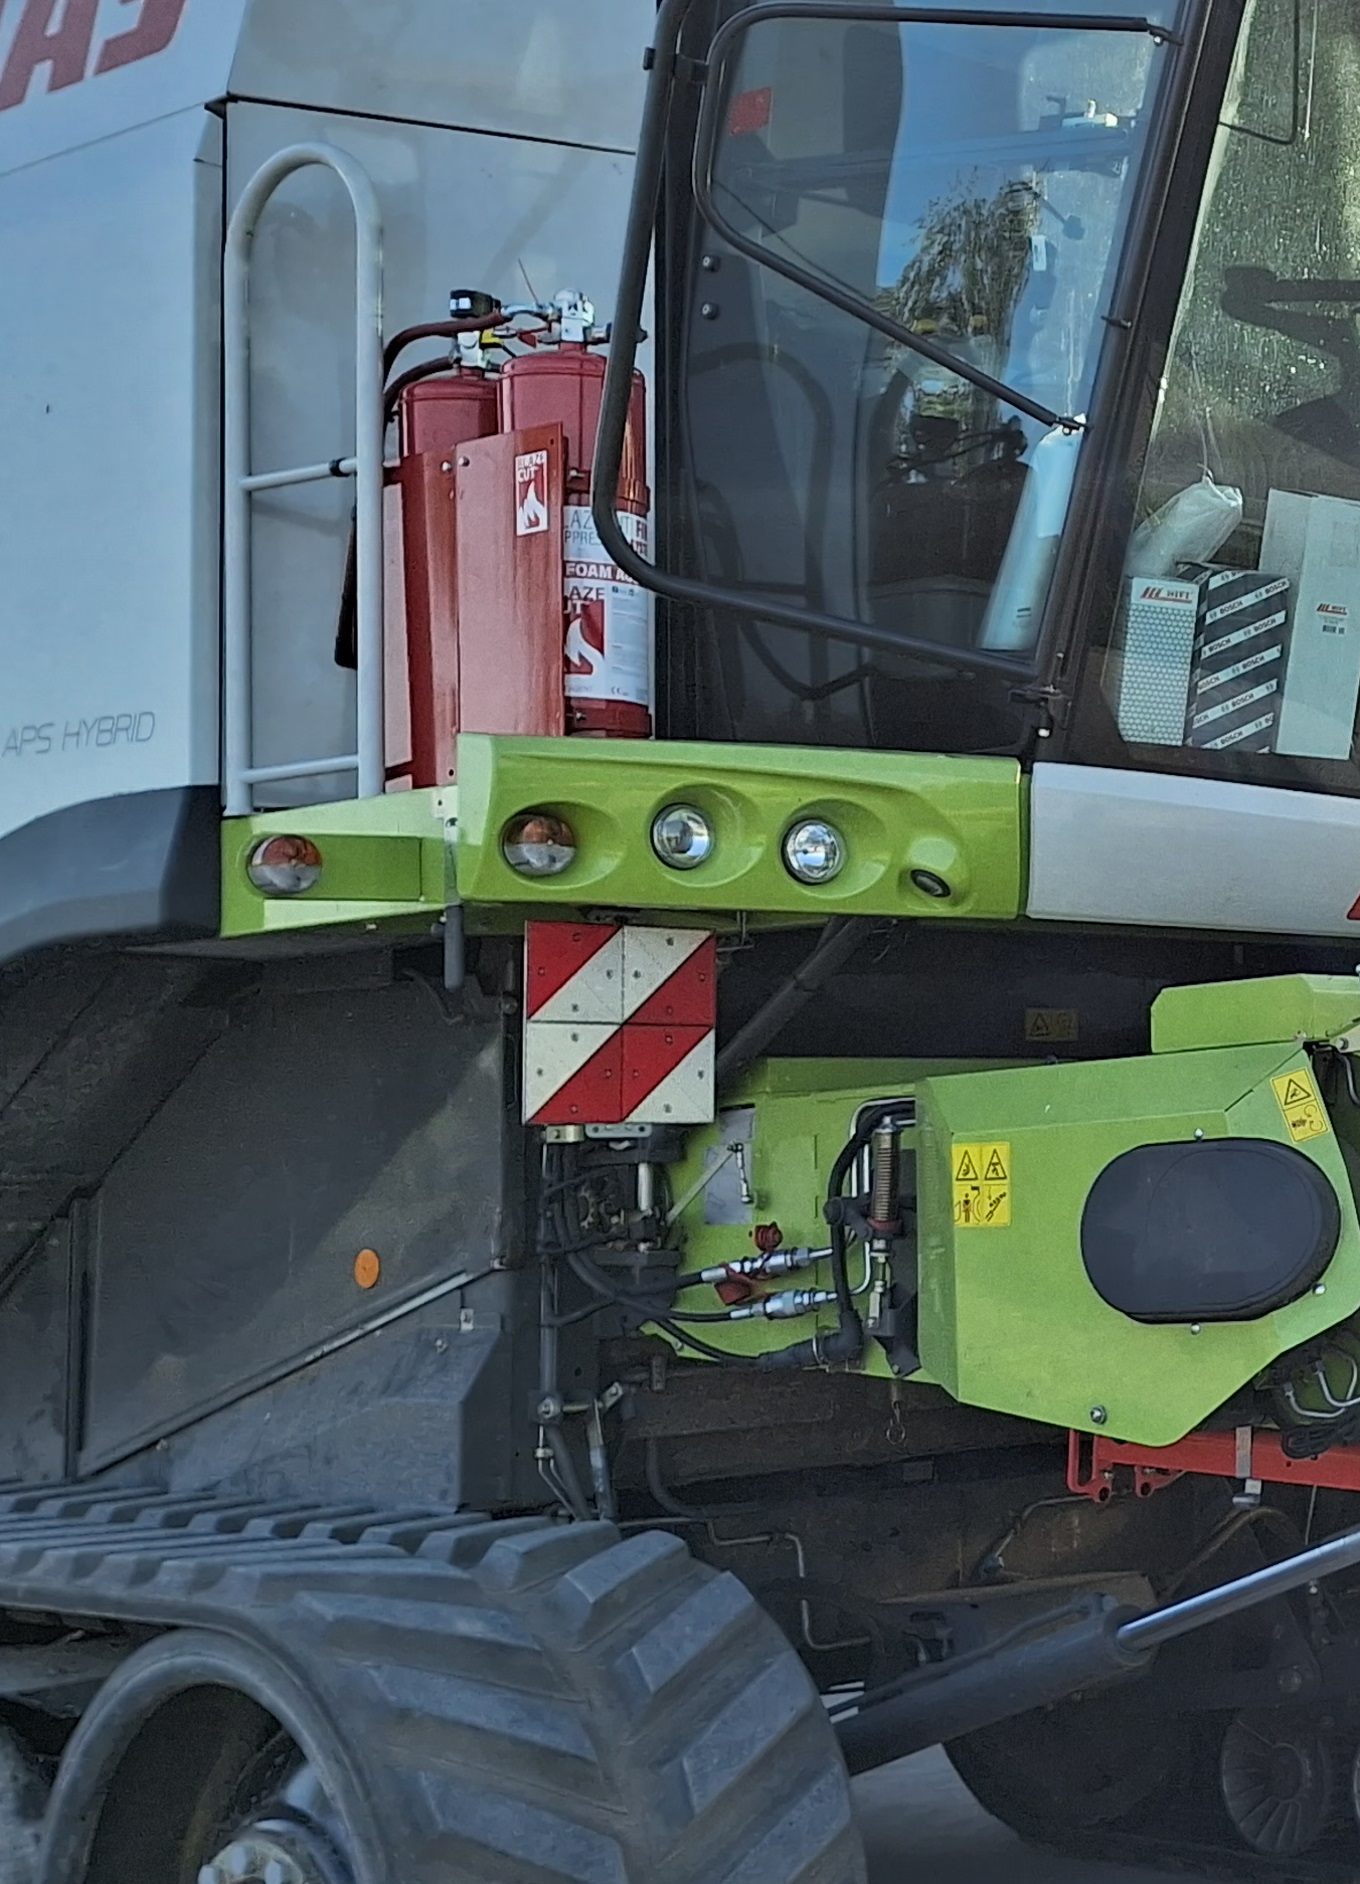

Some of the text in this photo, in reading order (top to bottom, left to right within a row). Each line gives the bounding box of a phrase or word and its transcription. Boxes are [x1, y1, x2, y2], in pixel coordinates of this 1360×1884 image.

[565, 562, 613, 579] FOAM
[2, 711, 155, 757] APS HYBRID
